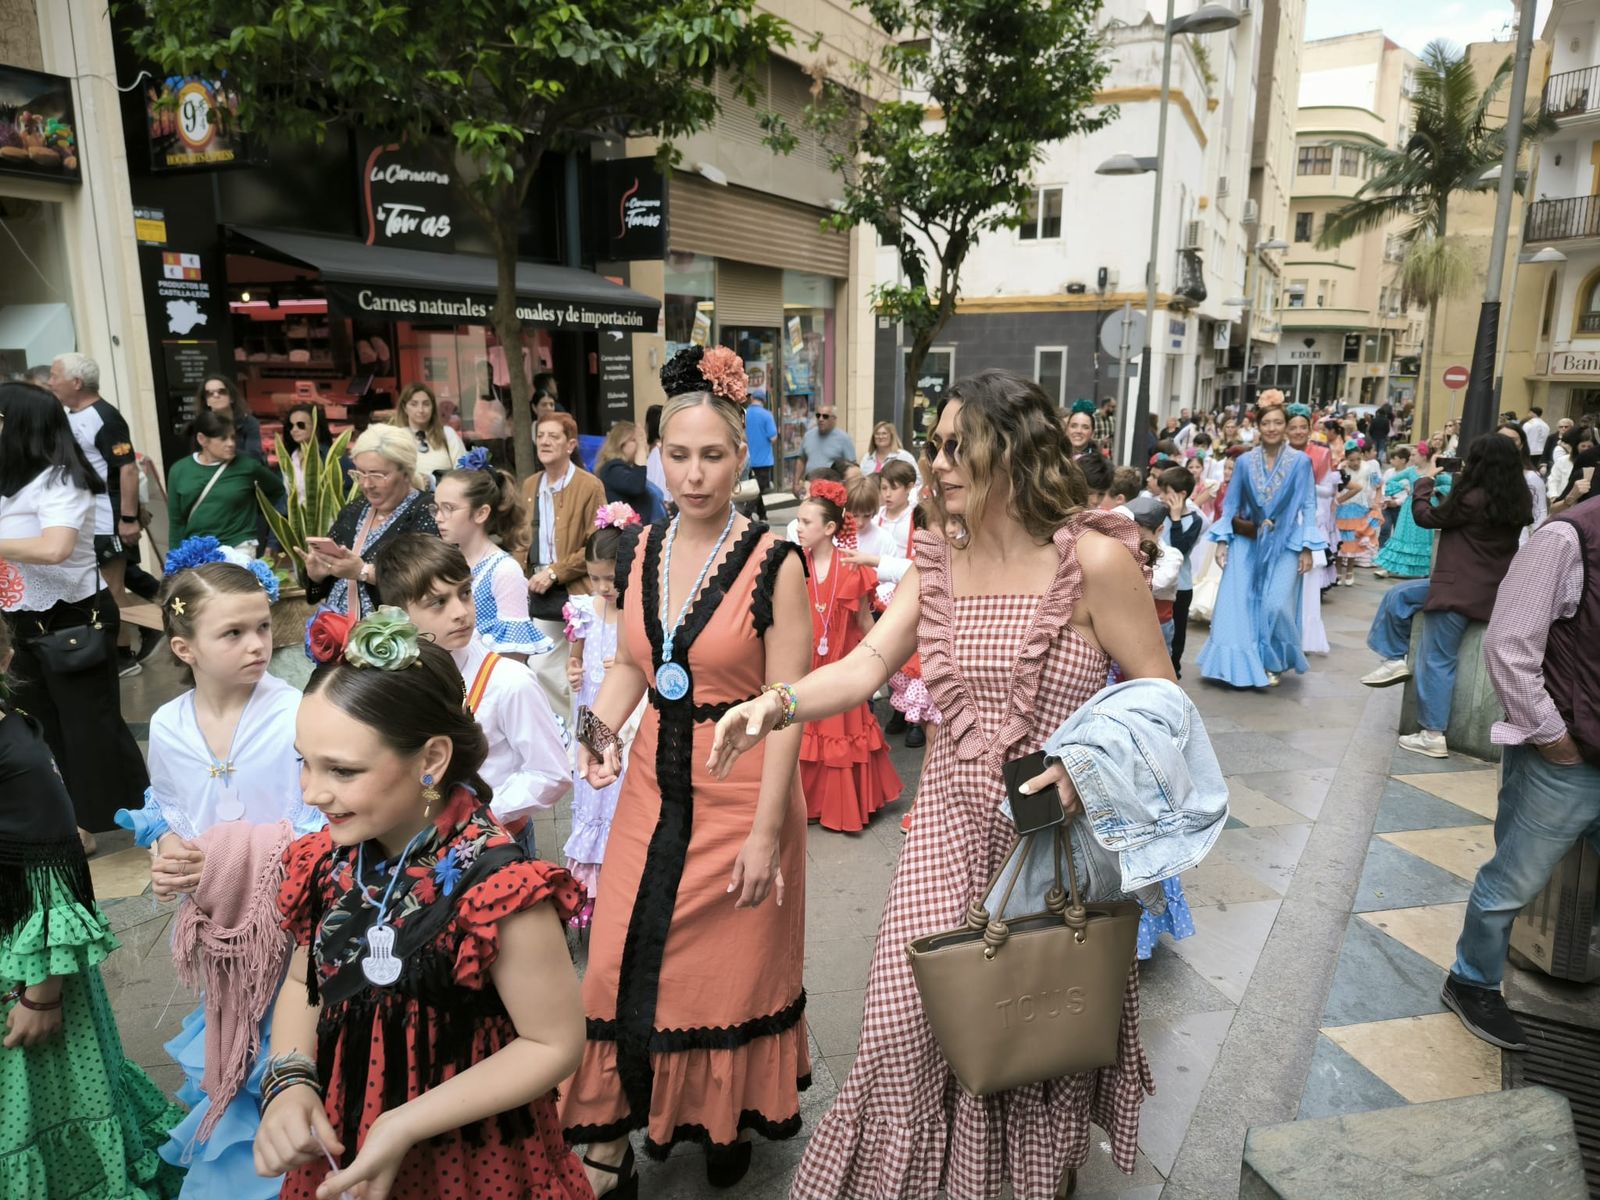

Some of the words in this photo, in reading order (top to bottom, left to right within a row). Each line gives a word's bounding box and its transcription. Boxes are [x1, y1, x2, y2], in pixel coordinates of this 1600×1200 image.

[358, 290, 417, 312] Carnes
[419, 297, 487, 317] naturales
[556, 309, 565, 327] y
[565, 305, 580, 322] de
[581, 308, 643, 328] importación
[1563, 355, 1600, 370] Ban
[994, 986, 1087, 1029] TOUS
